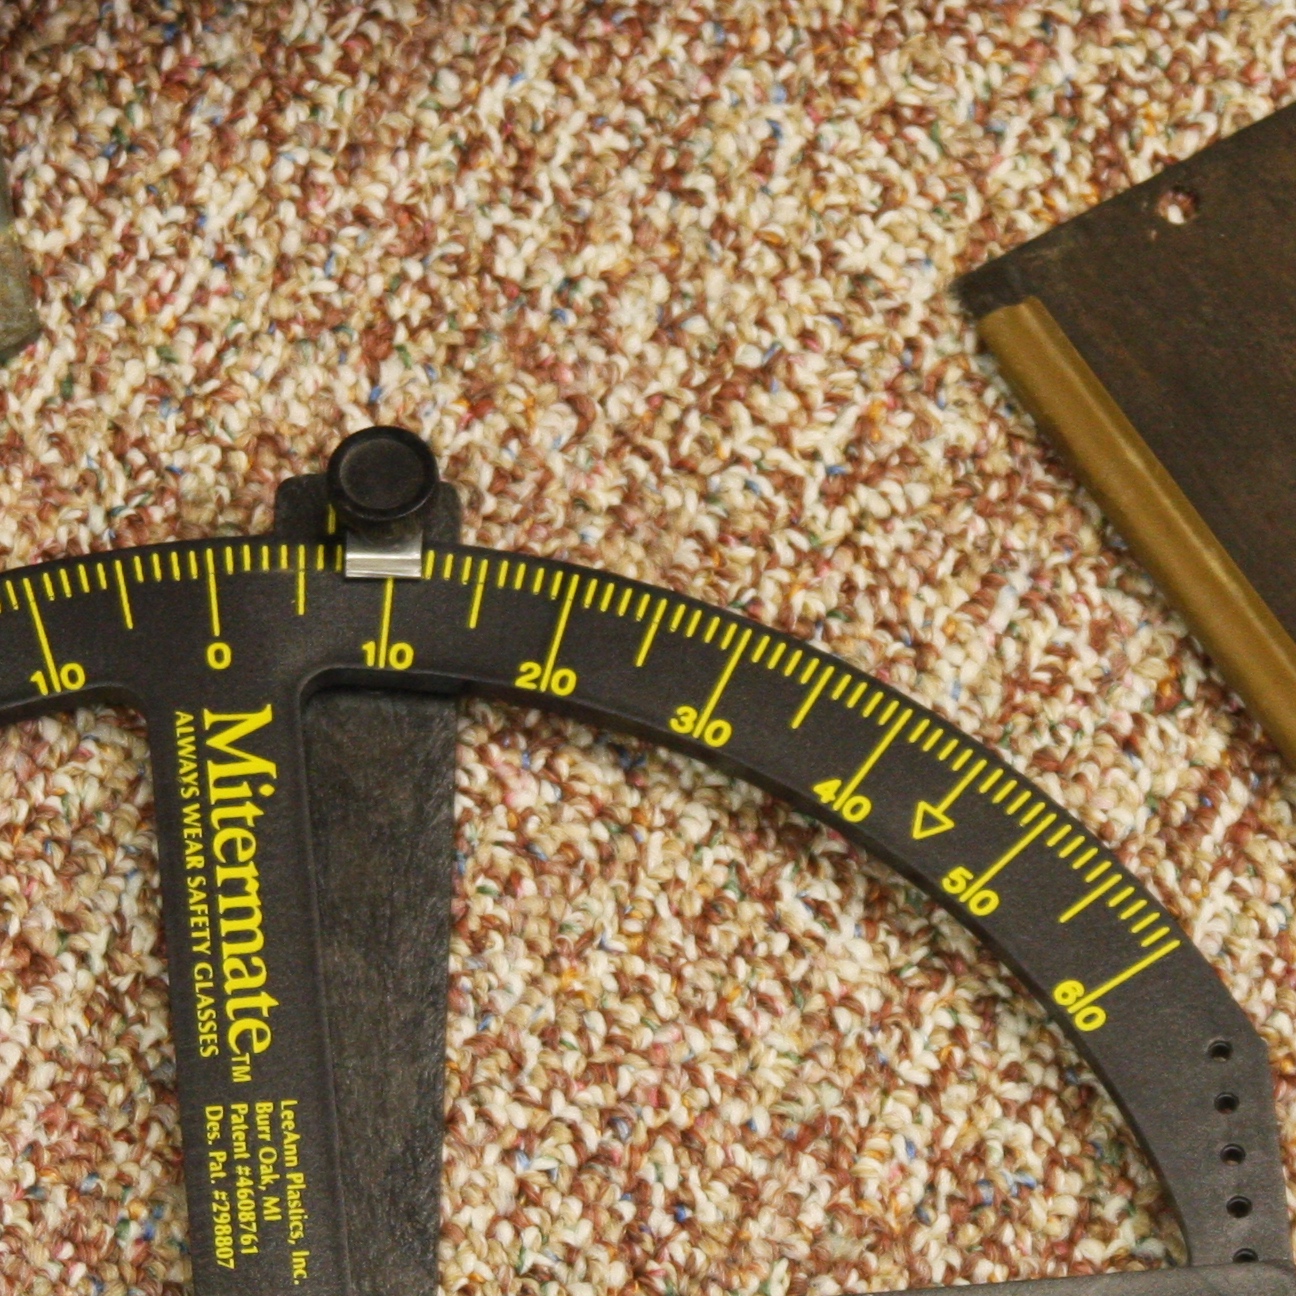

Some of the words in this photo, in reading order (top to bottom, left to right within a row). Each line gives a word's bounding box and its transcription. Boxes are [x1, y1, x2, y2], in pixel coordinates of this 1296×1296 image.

[175, 710, 199, 799] ALWAYS
[30, 663, 86, 695] 10
[206, 642, 232, 669] 0
[362, 641, 414, 668] 10
[516, 662, 577, 693] 20
[669, 705, 732, 748] 30
[813, 778, 872, 823] 40
[941, 866, 999, 917] 50
[1053, 980, 1107, 1032] 60
[183, 803, 204, 870] WEAR
[203, 704, 279, 1054] Mitermate
[187, 876, 211, 955] SAFETY
[194, 962, 218, 1058] GLASSES
[205, 1105, 223, 1145] Des.
[230, 1103, 250, 1160] Patent
[255, 1102, 273, 1141] Burr
[280, 1099, 301, 1167] LeeAnn
[209, 1151, 227, 1184] Pat.
[258, 1146, 280, 1191] Oak,
[212, 1190, 235, 1270] #298807
[235, 1164, 258, 1255] #4608761
[262, 1196, 282, 1221] MI
[286, 1172, 308, 1245] Plastics,
[292, 1251, 310, 1285] Inc.
